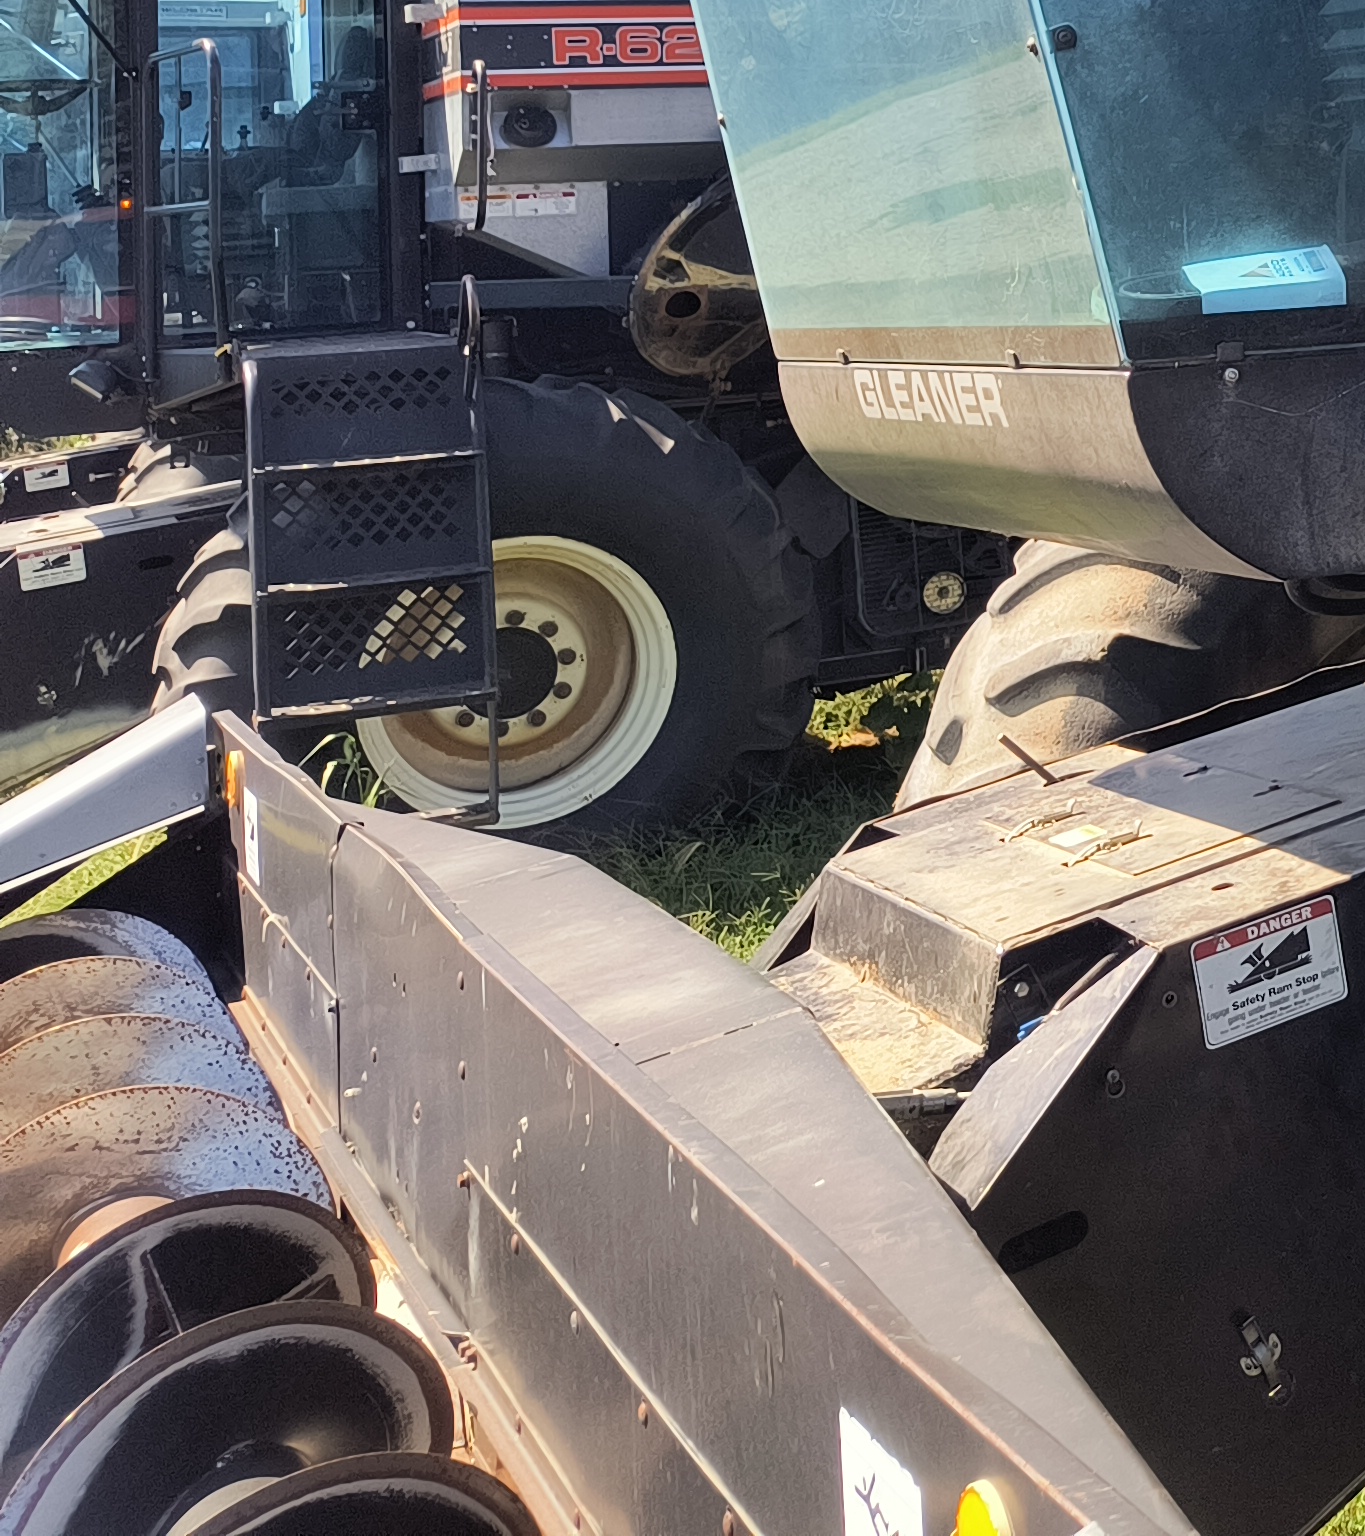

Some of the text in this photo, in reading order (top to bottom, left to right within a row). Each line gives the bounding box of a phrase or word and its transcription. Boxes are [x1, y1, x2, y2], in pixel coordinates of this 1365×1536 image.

[551, 25, 704, 66] R-62
[853, 369, 1010, 428] GLEANER
[1247, 906, 1313, 941] DANGER
[1231, 992, 1266, 1011] Safety
[1268, 983, 1293, 998] Ram
[1295, 973, 1319, 987] Stop
